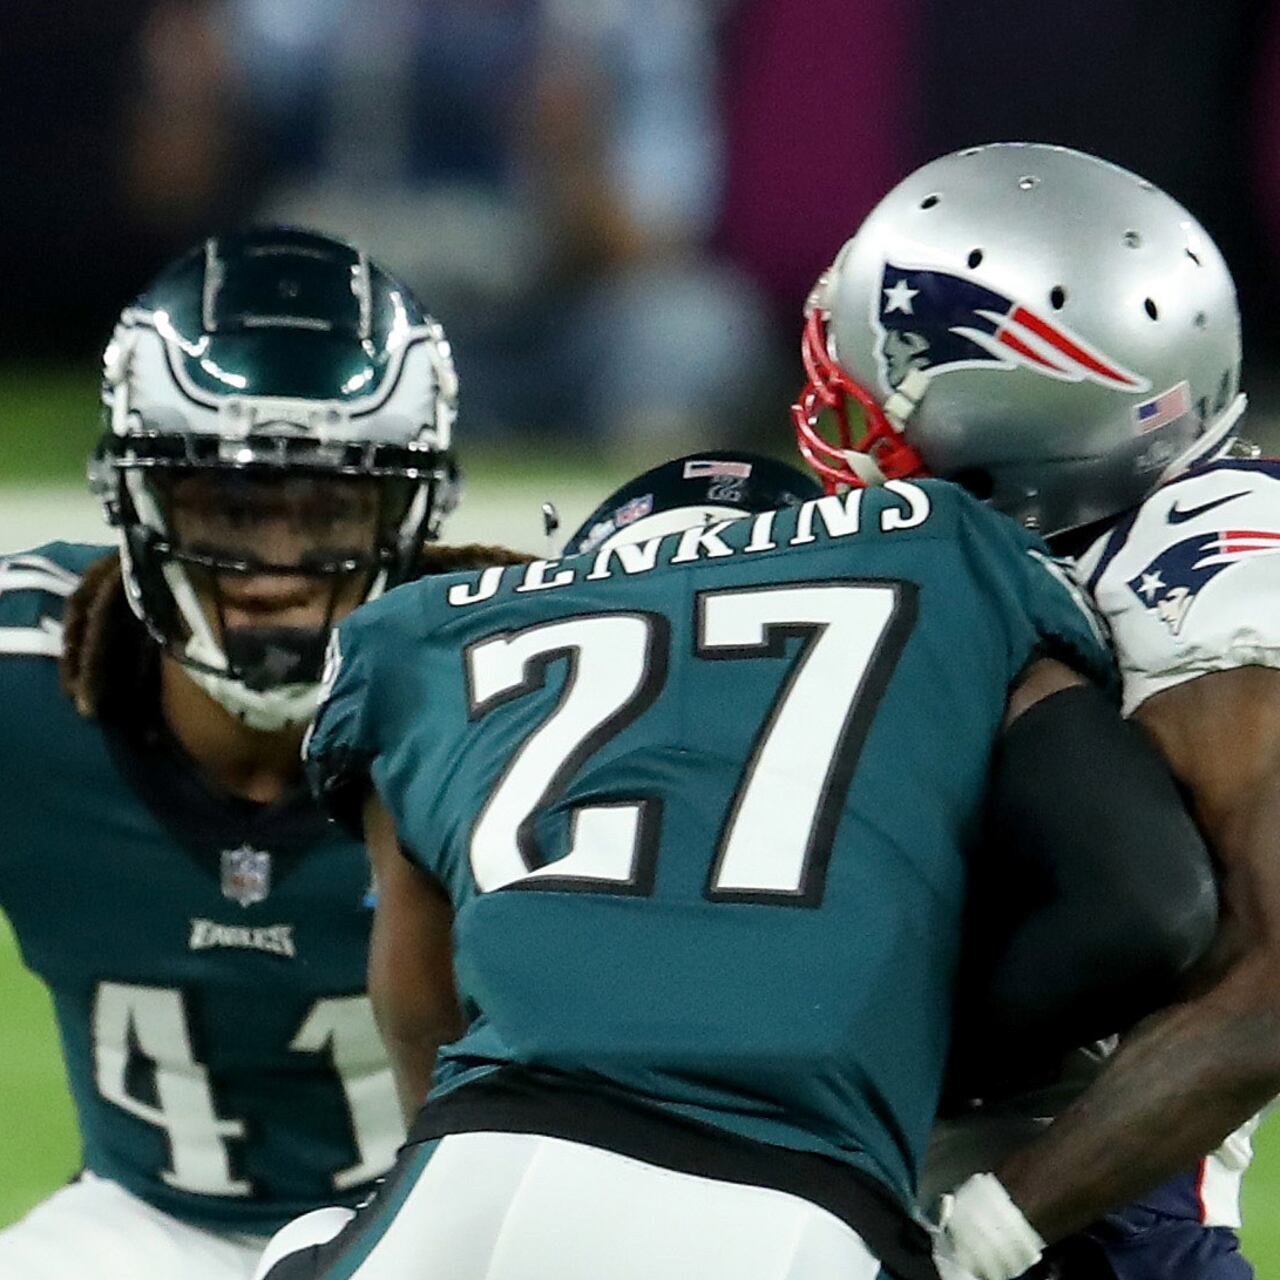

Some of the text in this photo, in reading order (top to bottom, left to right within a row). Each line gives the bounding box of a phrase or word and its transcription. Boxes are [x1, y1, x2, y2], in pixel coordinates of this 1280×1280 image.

[448, 481, 933, 607] JENKINS
[465, 580, 919, 907] 27
[93, 980, 408, 1196] 41
